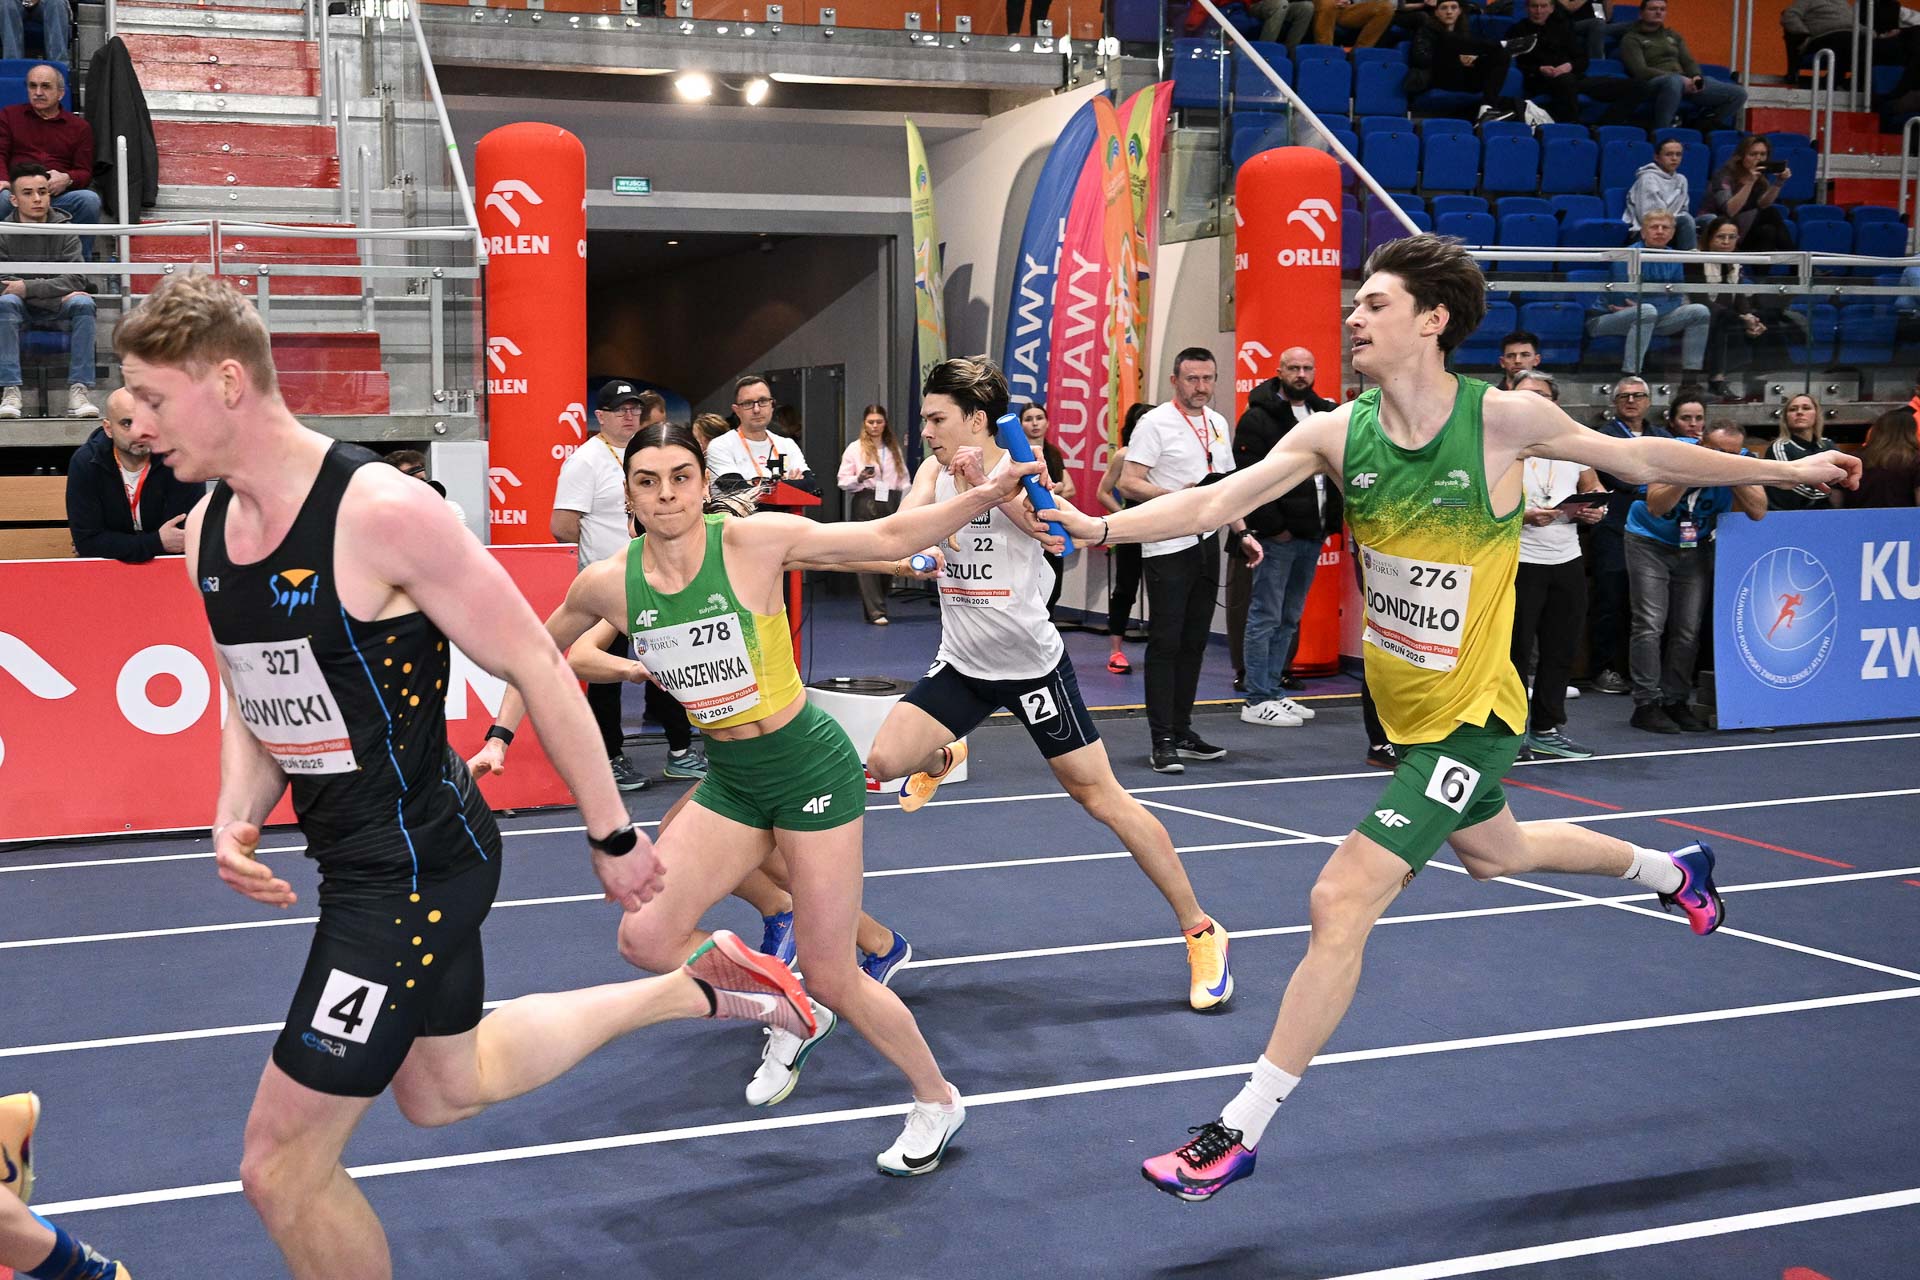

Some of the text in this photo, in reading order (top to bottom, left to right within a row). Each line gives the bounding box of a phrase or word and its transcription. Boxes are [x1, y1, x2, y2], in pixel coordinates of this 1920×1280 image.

[1278, 248, 1340, 267] ORLEN
[1058, 249, 1101, 470] KUJAWY
[486, 378, 527, 394] RLEN
[1351, 472, 1378, 489] 4F
[973, 538, 994, 552] 22
[946, 562, 993, 580] SZULC
[1409, 565, 1457, 590] 276
[269, 574, 320, 617] Sopot
[636, 609, 658, 627] 4F
[1367, 586, 1460, 632] DONDZIŁO
[689, 621, 731, 647] 278
[1380, 638, 1426, 664] TORUŃ 2026
[1433, 645, 1454, 656] Polski
[262, 649, 299, 675] 327
[697, 695, 735, 708] Mistrzostwa
[735, 687, 754, 699] Polski
[1028, 693, 1052, 720] 2
[709, 705, 734, 718] 2026
[1440, 766, 1470, 803] 6
[802, 793, 833, 814] 4F
[1374, 808, 1412, 828] 4F
[328, 985, 369, 1034] 4
